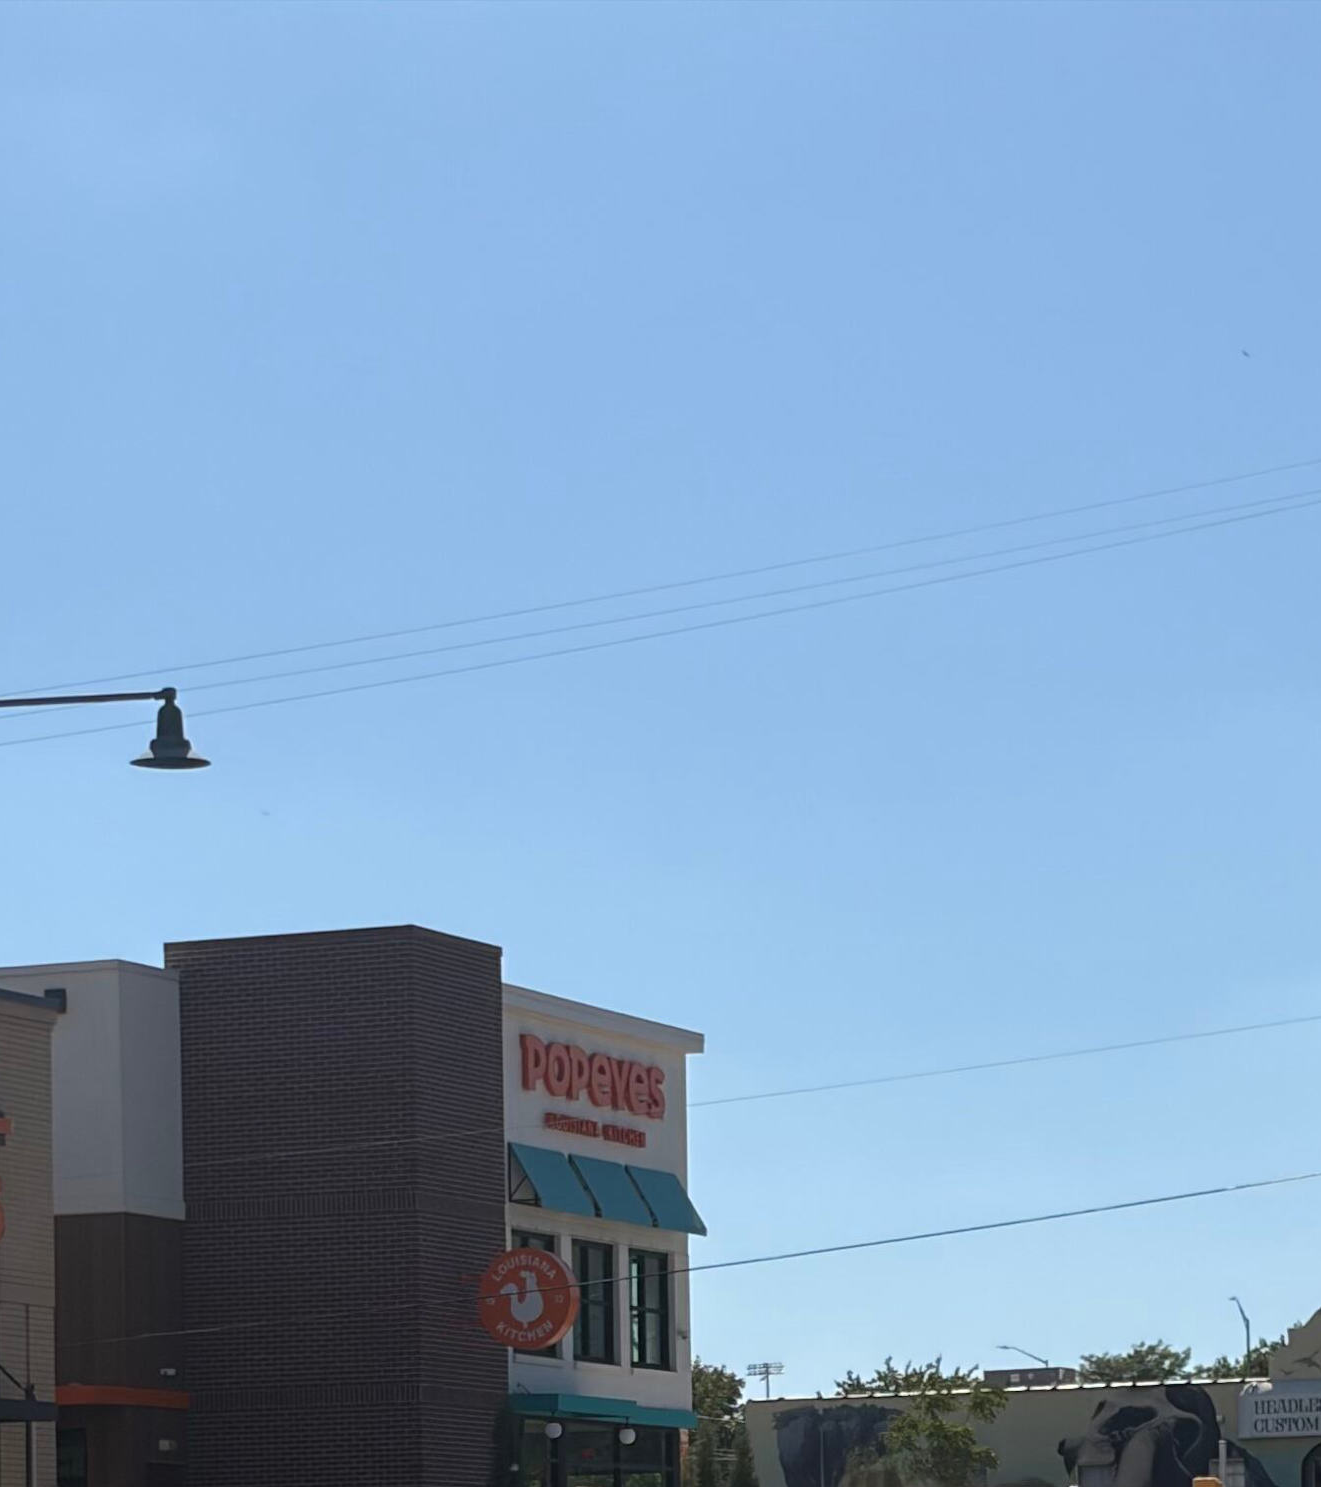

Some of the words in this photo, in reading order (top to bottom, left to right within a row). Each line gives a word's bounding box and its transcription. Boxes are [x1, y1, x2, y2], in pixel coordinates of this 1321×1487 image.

[491, 1255, 556, 1281] LOUISIANA
[496, 1321, 554, 1341] KITCHEN
[1254, 1416, 1319, 1433] CUSTOM
